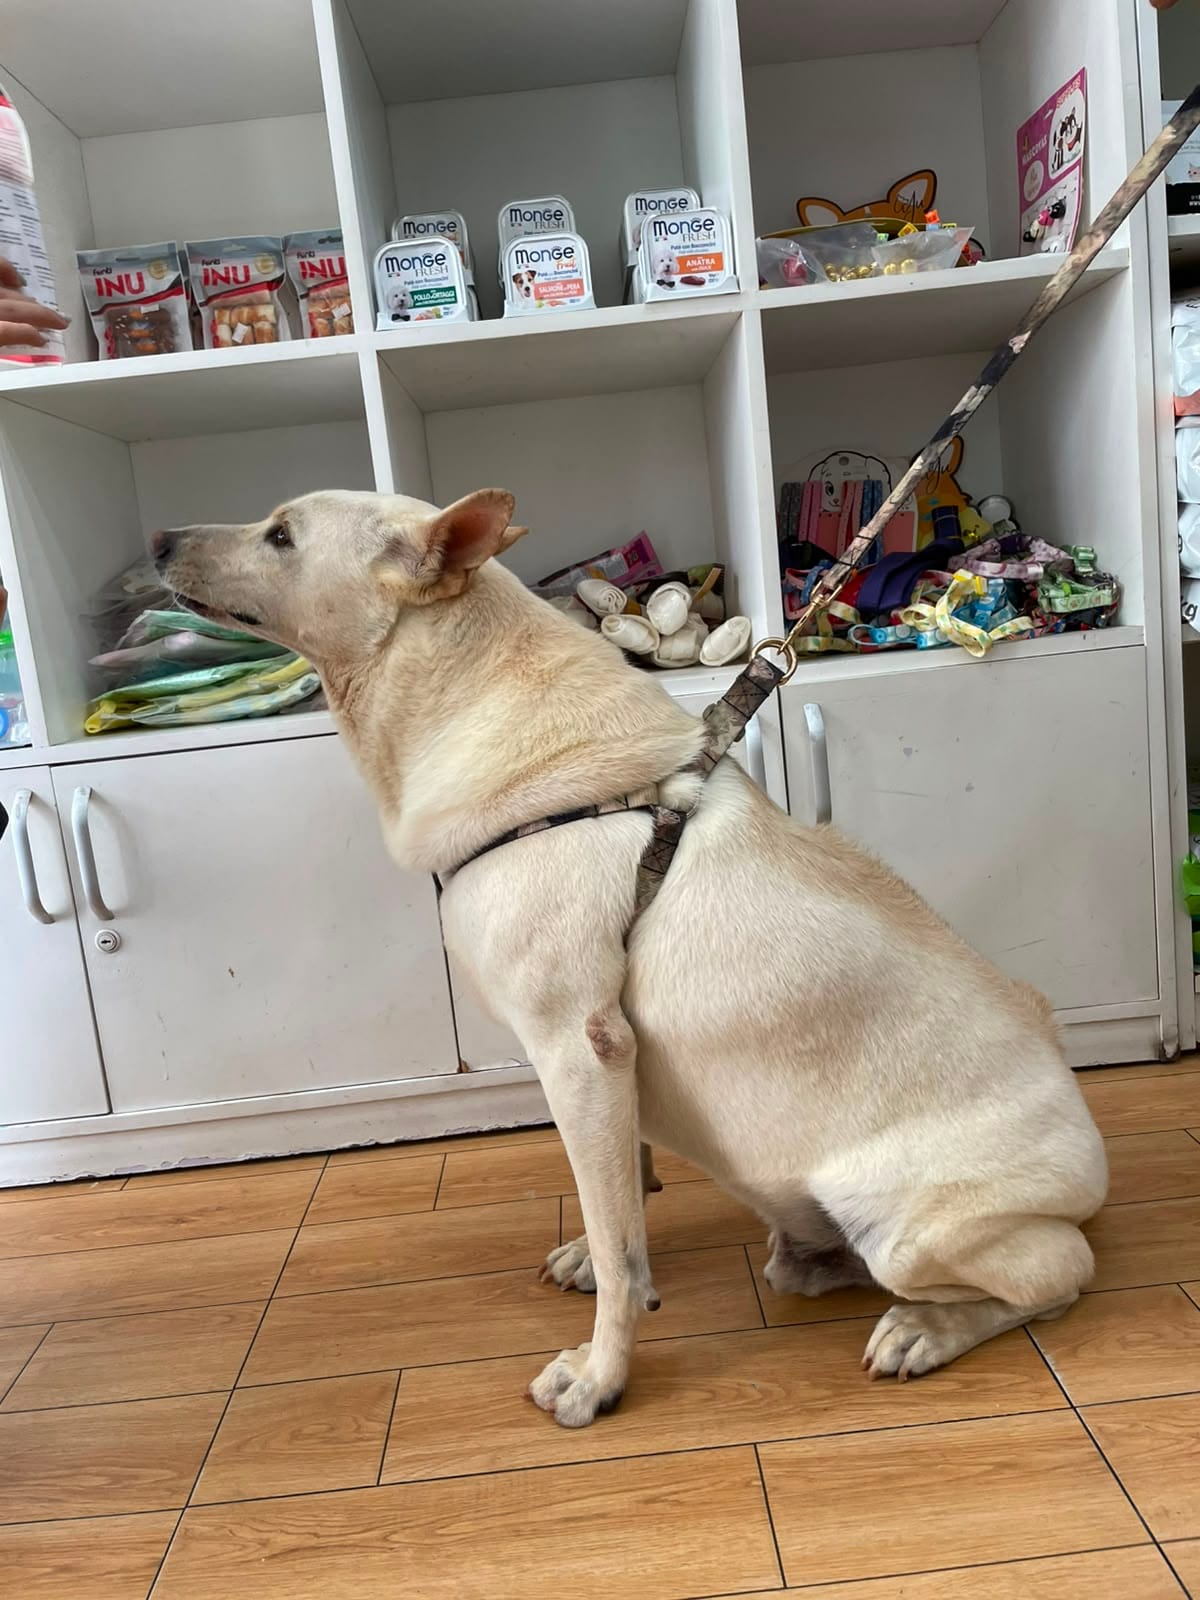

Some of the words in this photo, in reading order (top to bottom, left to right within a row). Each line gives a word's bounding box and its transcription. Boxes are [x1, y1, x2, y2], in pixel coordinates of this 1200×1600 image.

[682, 231, 716, 243] FRESH
[299, 256, 347, 280] INU
[686, 258, 716, 267] ANATRA
[203, 264, 251, 287] INU
[415, 265, 449, 278] FRESH
[95, 271, 145, 297] INU
[413, 293, 430, 301] POLLO
